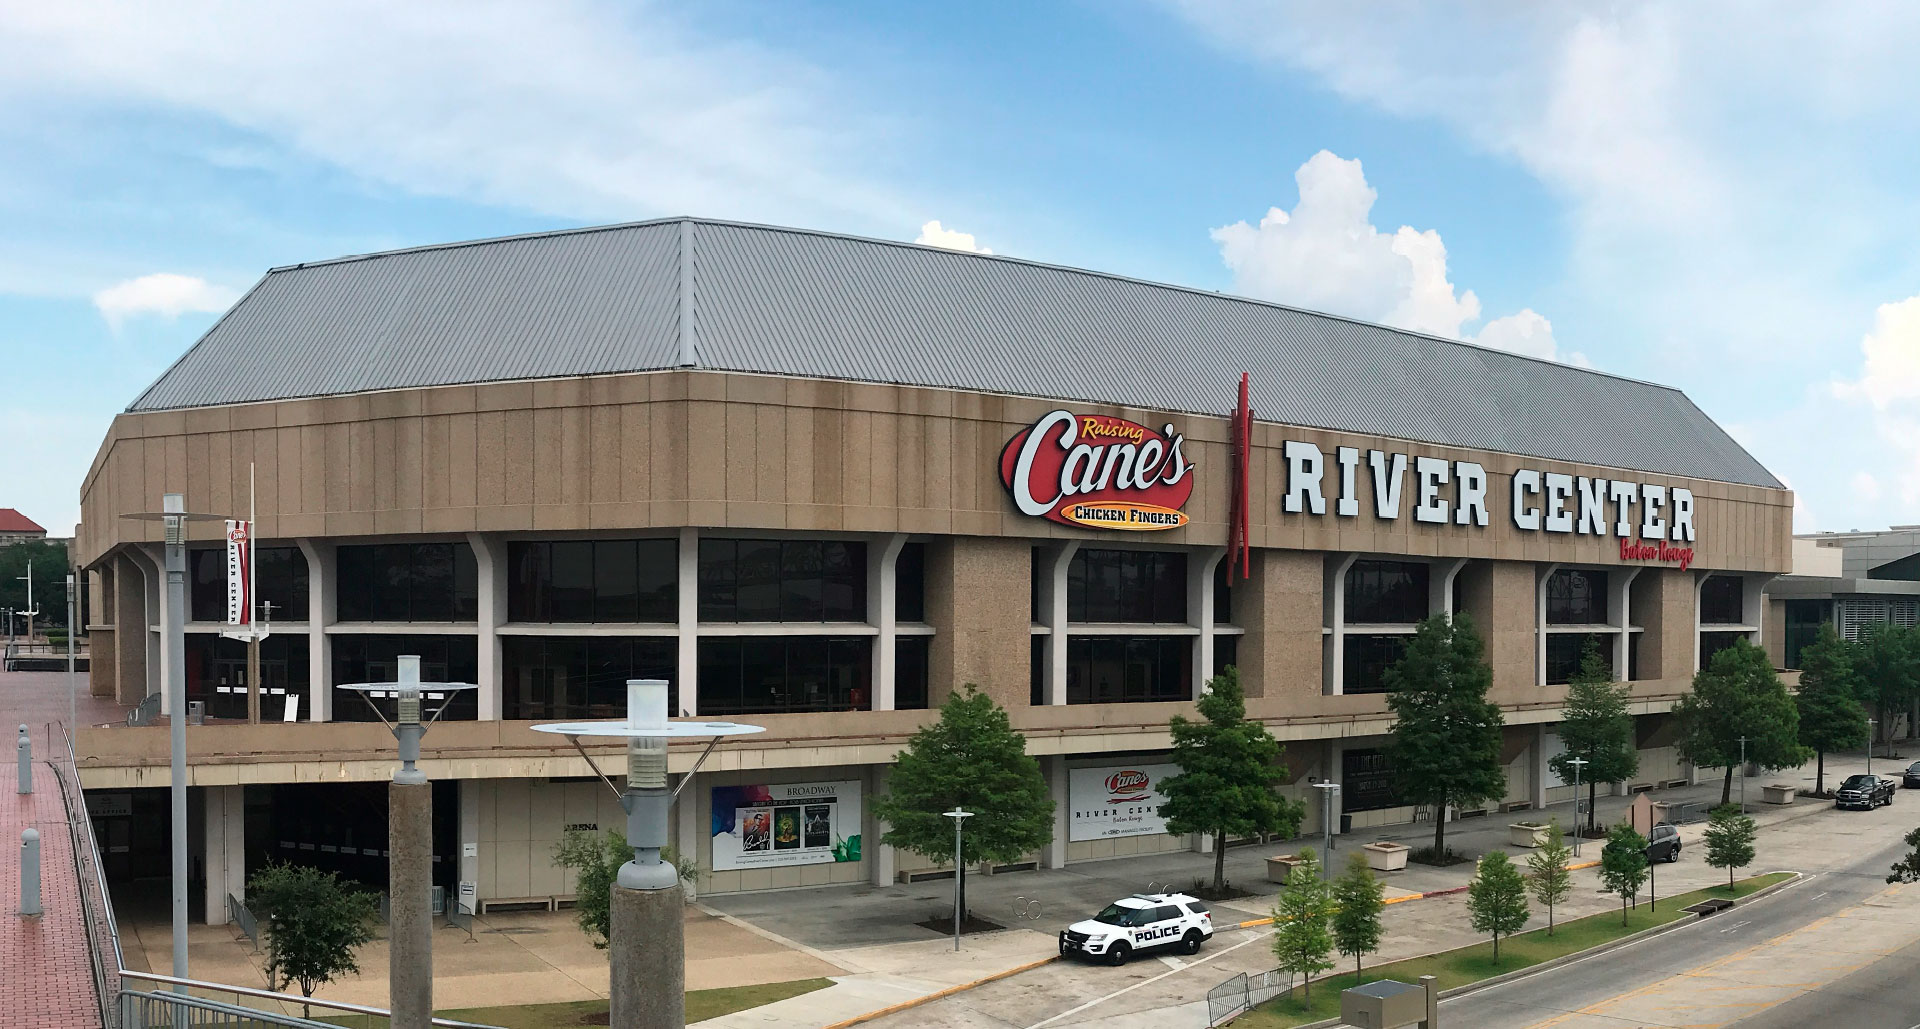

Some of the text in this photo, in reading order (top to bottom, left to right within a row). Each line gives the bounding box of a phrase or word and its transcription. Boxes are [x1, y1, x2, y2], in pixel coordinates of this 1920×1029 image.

[1081, 417, 1144, 445] Raising
[1013, 409, 1196, 517] Cane's
[1282, 439, 1696, 542] RIVER CENTER
[1074, 505, 1180, 526] CHICKEN FINGERS
[1620, 537, 1694, 572] Baton Rouge
[787, 785, 837, 796] BROADWAY
[1076, 809, 1118, 818] RIVER
[1135, 925, 1181, 943] POLICE
